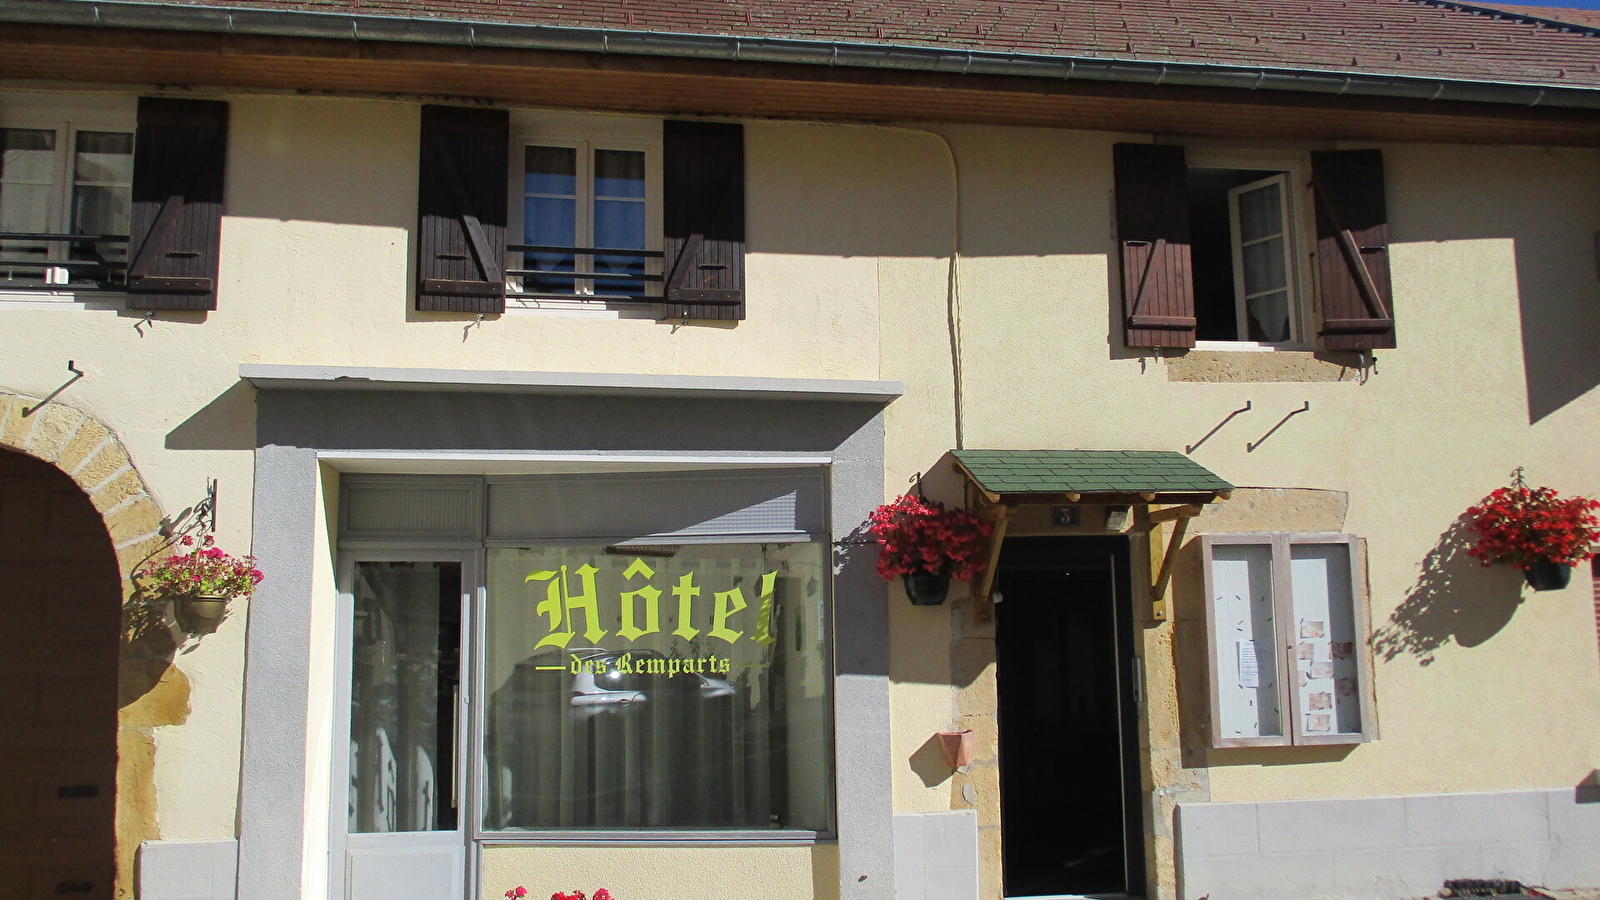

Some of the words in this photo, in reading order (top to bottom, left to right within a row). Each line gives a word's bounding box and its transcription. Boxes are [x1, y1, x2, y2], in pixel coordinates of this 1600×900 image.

[1060, 508, 1071, 525] 3
[524, 556, 779, 650] Hôtel
[569, 653, 607, 675] des
[614, 652, 732, 679] Remparts
